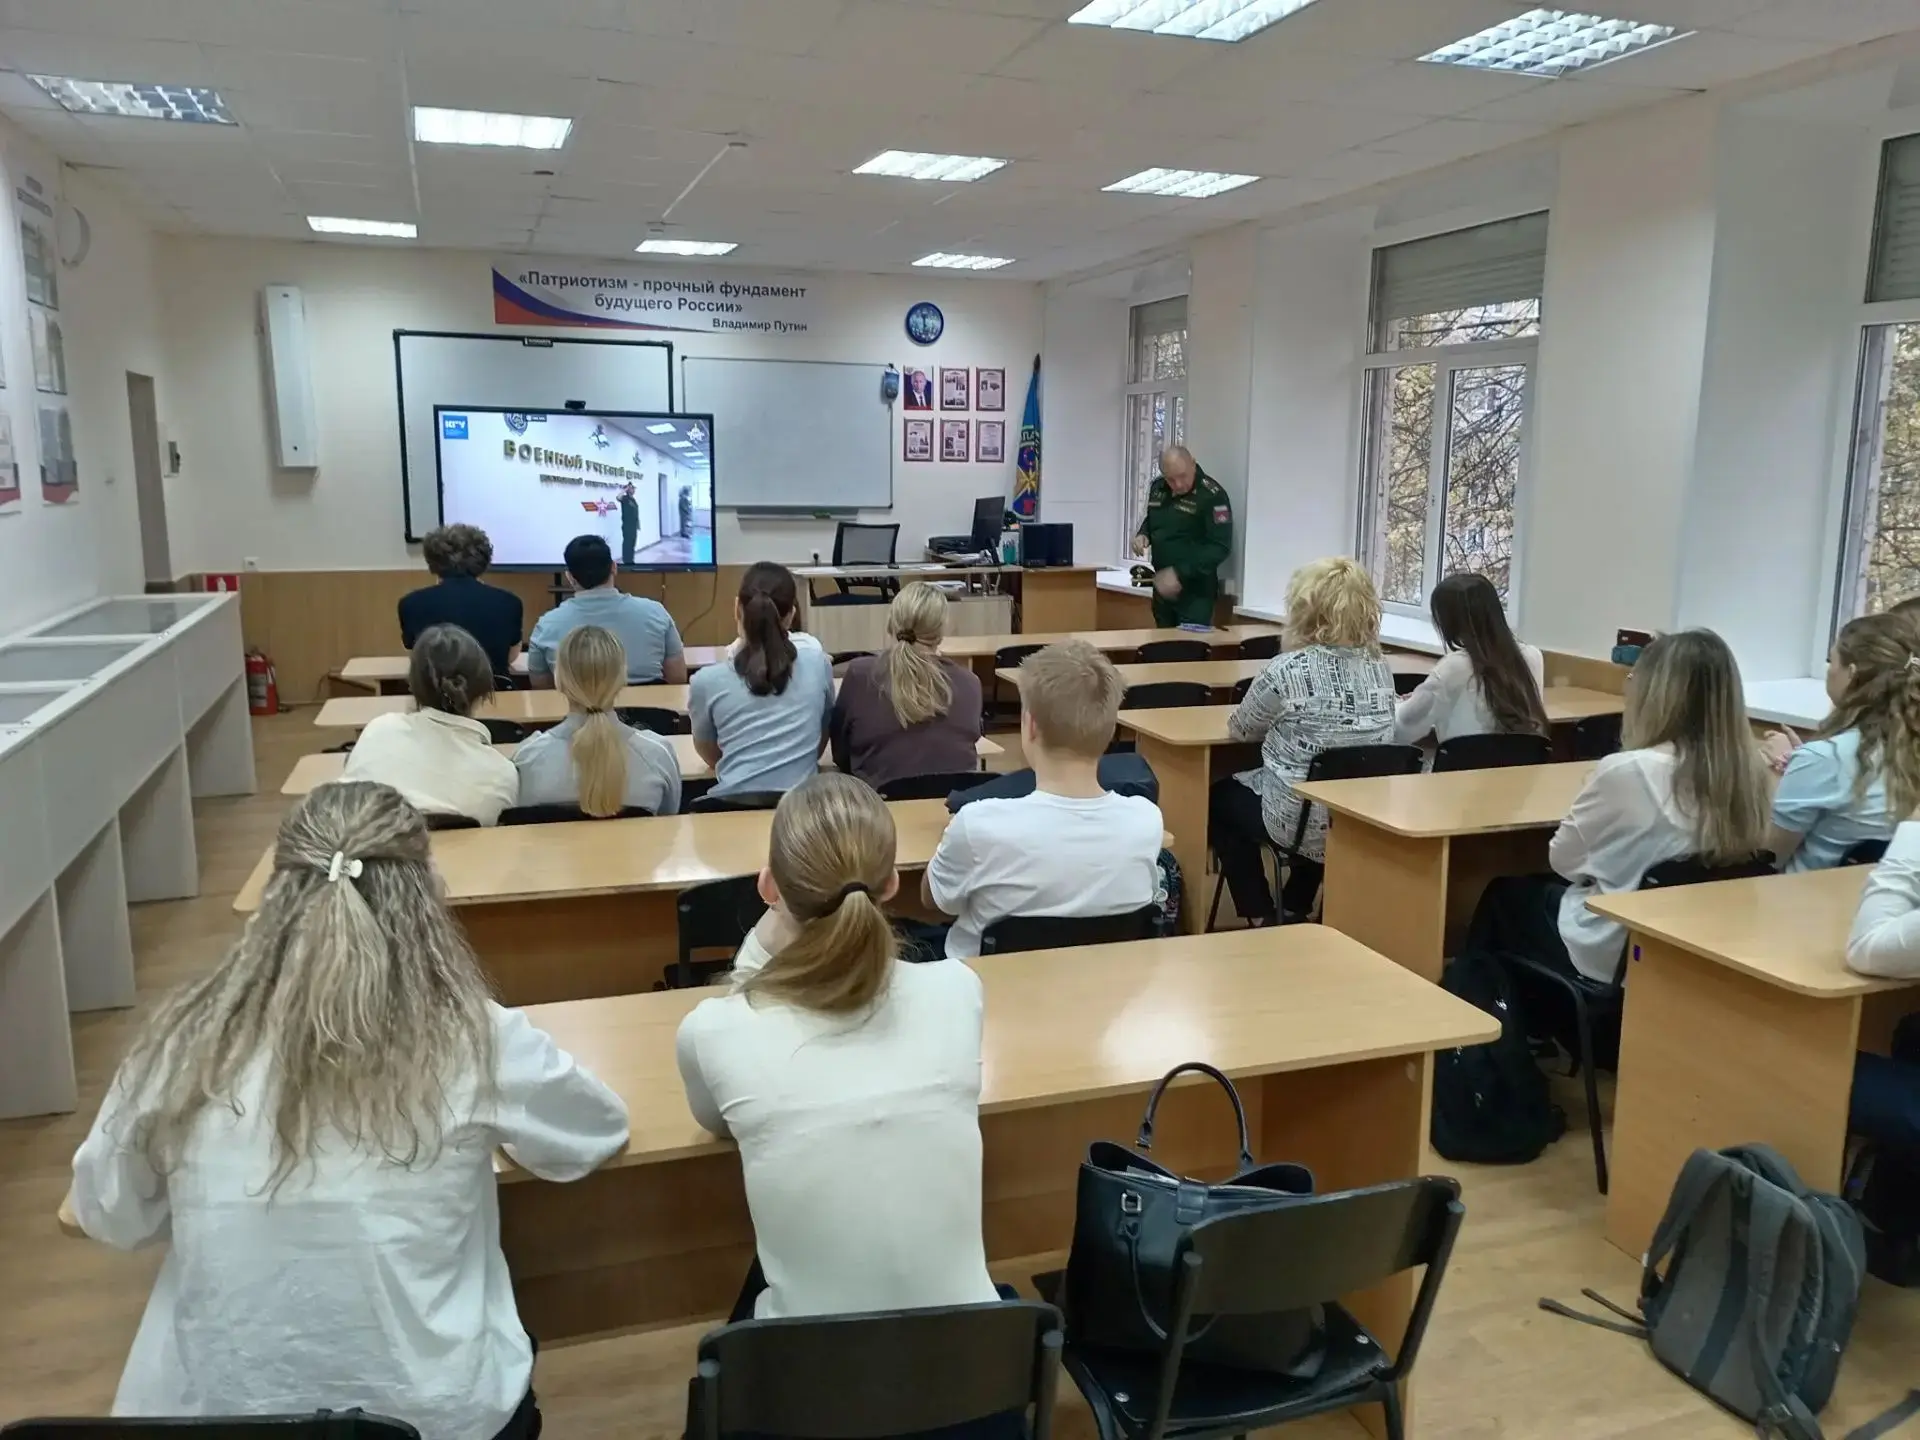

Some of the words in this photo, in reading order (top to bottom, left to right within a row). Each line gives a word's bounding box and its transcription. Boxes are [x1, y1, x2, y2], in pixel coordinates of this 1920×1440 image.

[519, 270, 628, 289] «Патриотизм
[643, 280, 715, 293] прочный
[719, 281, 807, 298] фундамент
[594, 293, 673, 311] будущего
[678, 297, 743, 312] России»
[712, 317, 771, 331] Владимир
[774, 320, 807, 333] Путин
